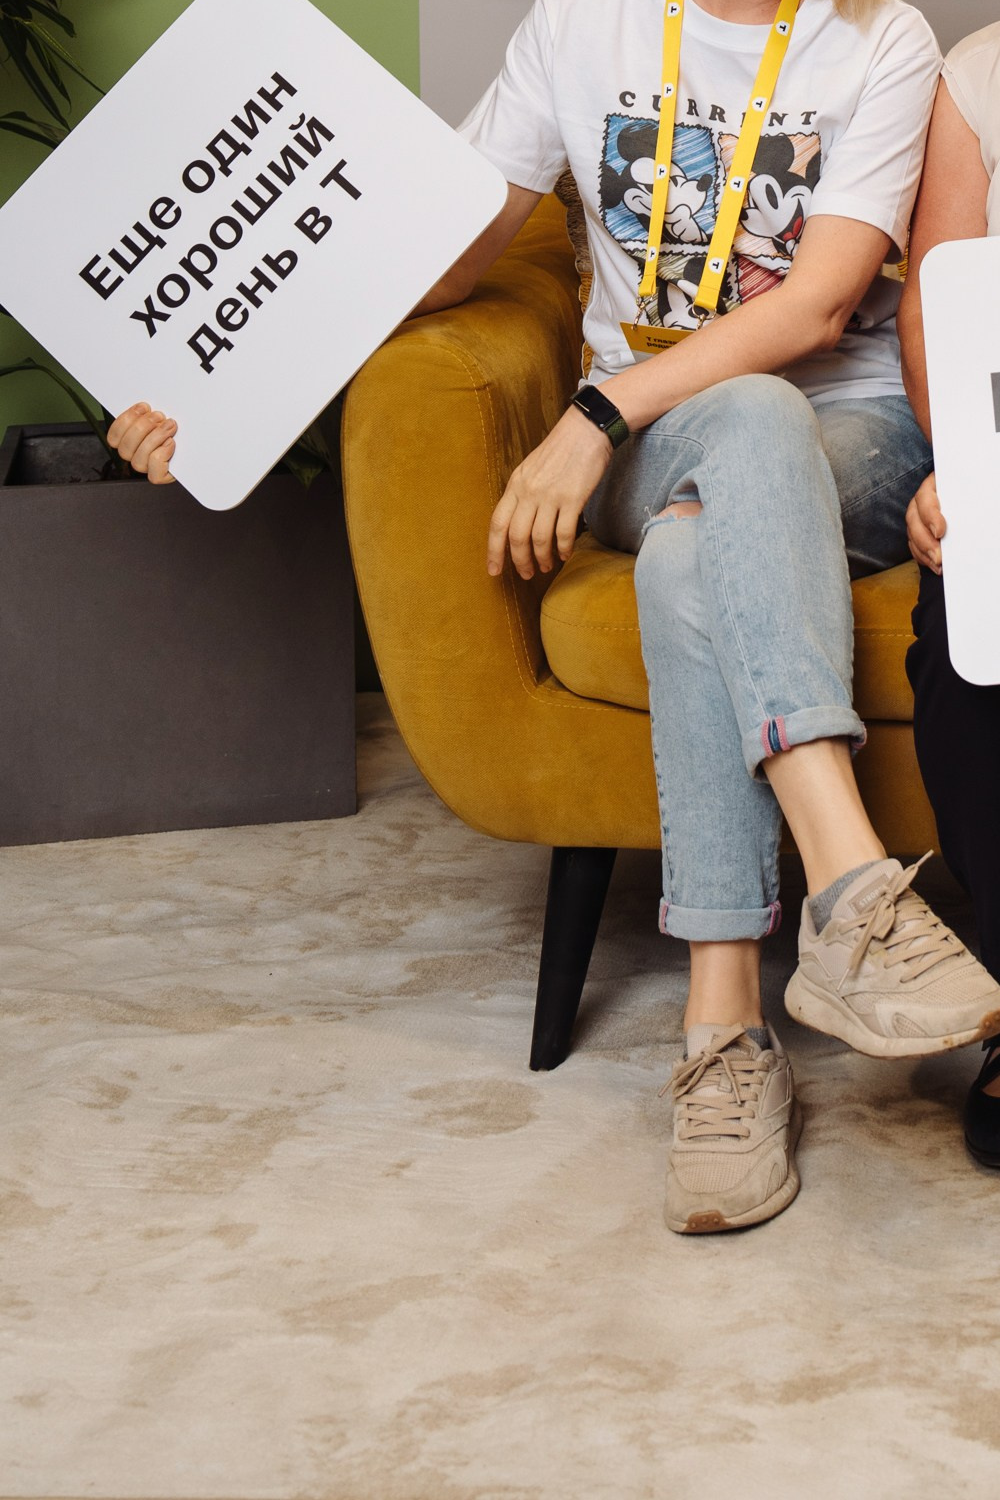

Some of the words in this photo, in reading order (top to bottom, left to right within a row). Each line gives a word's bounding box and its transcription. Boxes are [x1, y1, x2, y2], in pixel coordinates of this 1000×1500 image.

[79, 197, 182, 301] Еще
[182, 72, 298, 193] один
[619, 90, 817, 127] CURRNT
[130, 112, 335, 339] хороший
[187, 249, 298, 374] день
[294, 206, 333, 245] в
[319, 158, 362, 201] Т
